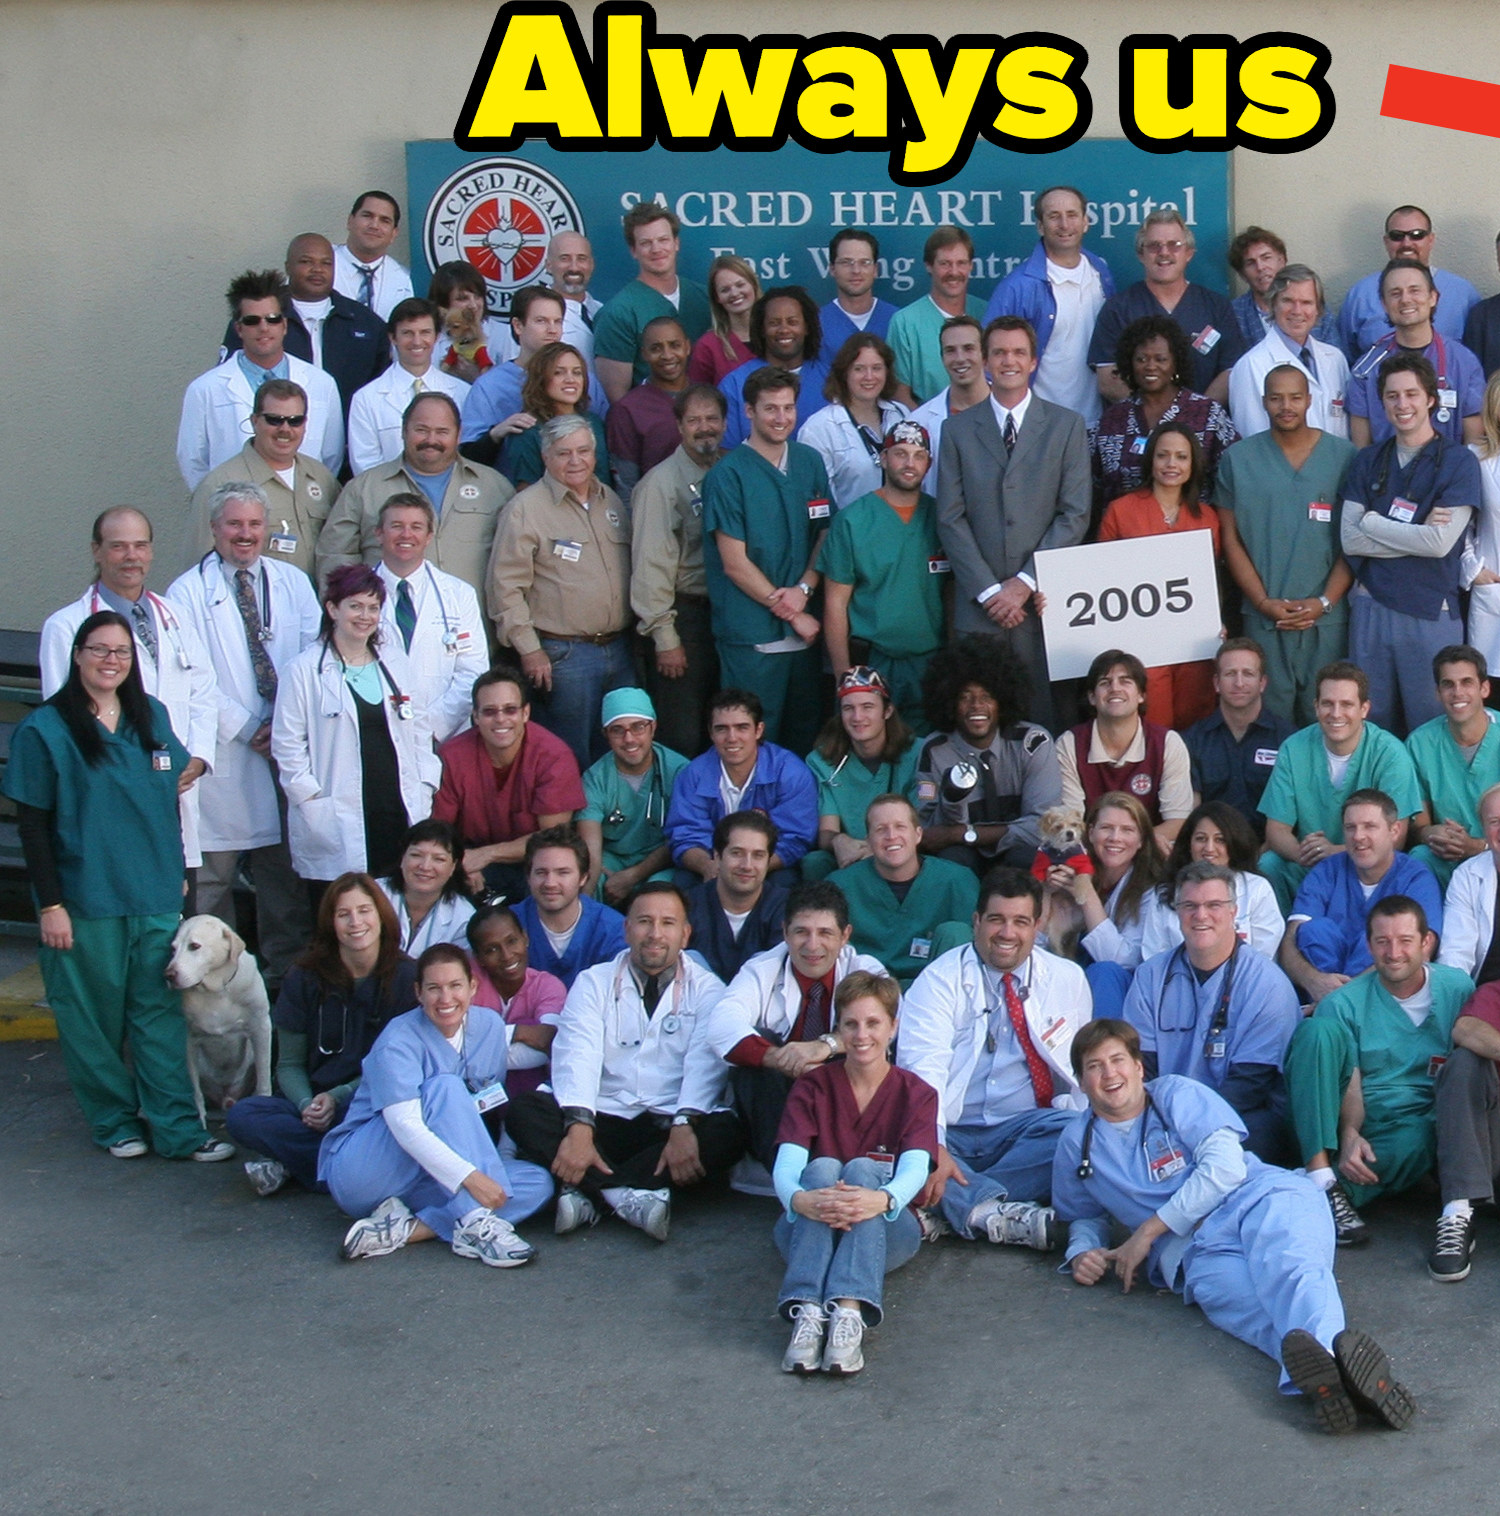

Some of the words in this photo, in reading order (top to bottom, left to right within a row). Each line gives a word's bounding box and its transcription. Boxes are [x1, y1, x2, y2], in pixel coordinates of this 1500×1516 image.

[438, 172, 505, 247] SACRED
[512, 173, 568, 231] HEAR
[829, 190, 1002, 227] HEART
[1065, 576, 1194, 628] 2005
